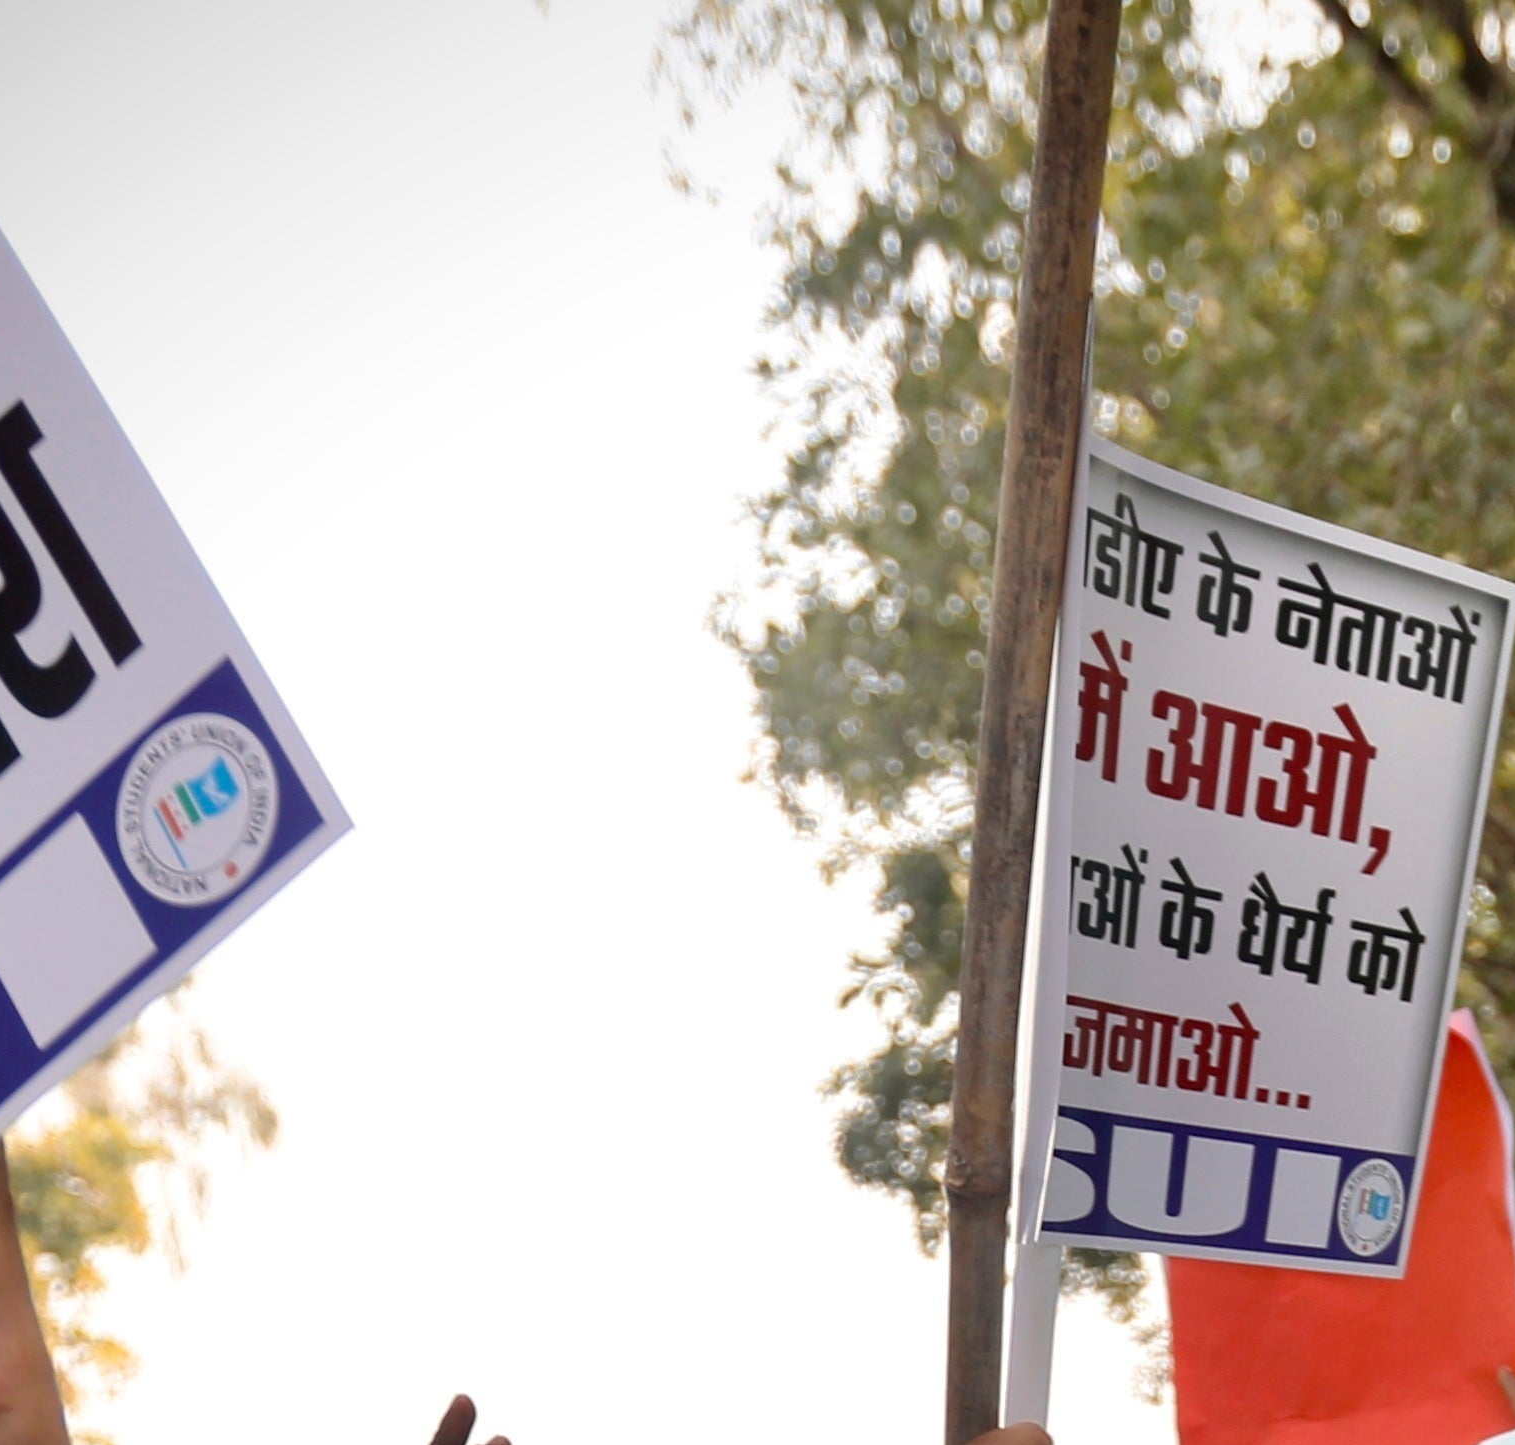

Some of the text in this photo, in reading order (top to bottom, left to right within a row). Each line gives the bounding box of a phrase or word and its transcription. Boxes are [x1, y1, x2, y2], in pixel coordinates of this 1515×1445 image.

[1083, 492, 1483, 705] डीए के नेताओं
[1145, 688, 1393, 877] आओ,
[1158, 856, 1224, 961] के
[1237, 870, 1337, 985] धैर्य
[1346, 906, 1427, 1003] को
